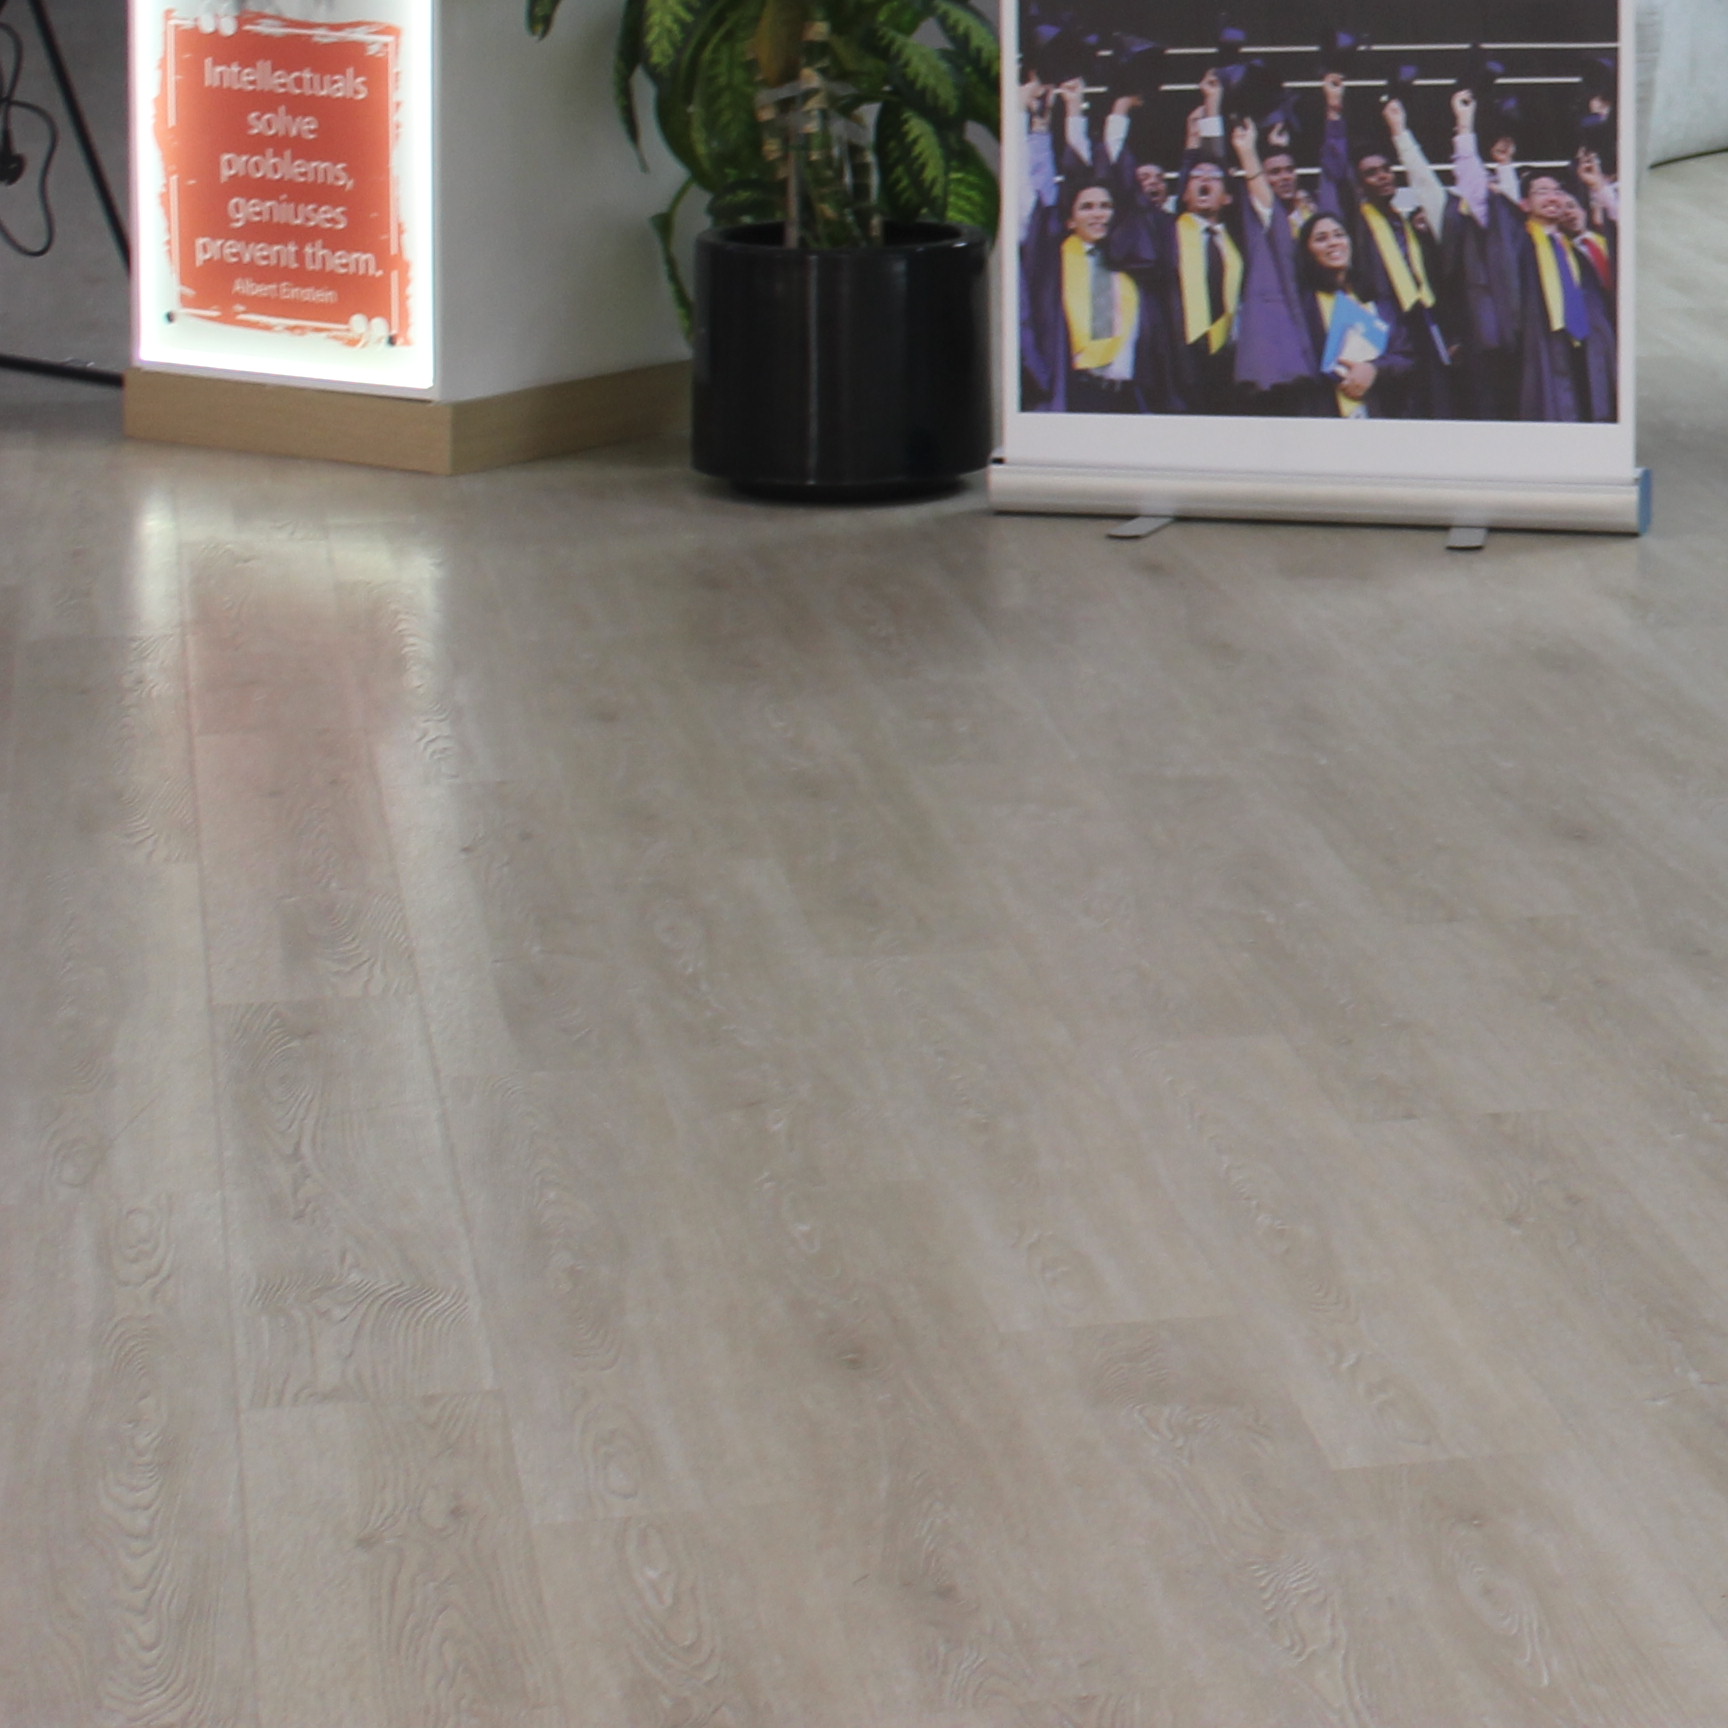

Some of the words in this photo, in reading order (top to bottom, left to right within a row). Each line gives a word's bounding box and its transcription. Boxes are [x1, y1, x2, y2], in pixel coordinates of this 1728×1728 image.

[204, 57, 369, 100] Intellectuals
[247, 105, 319, 139] solve
[220, 148, 355, 191] problems,
[227, 194, 348, 230] geniuses
[195, 235, 299, 271] prevent
[304, 238, 384, 278] them.
